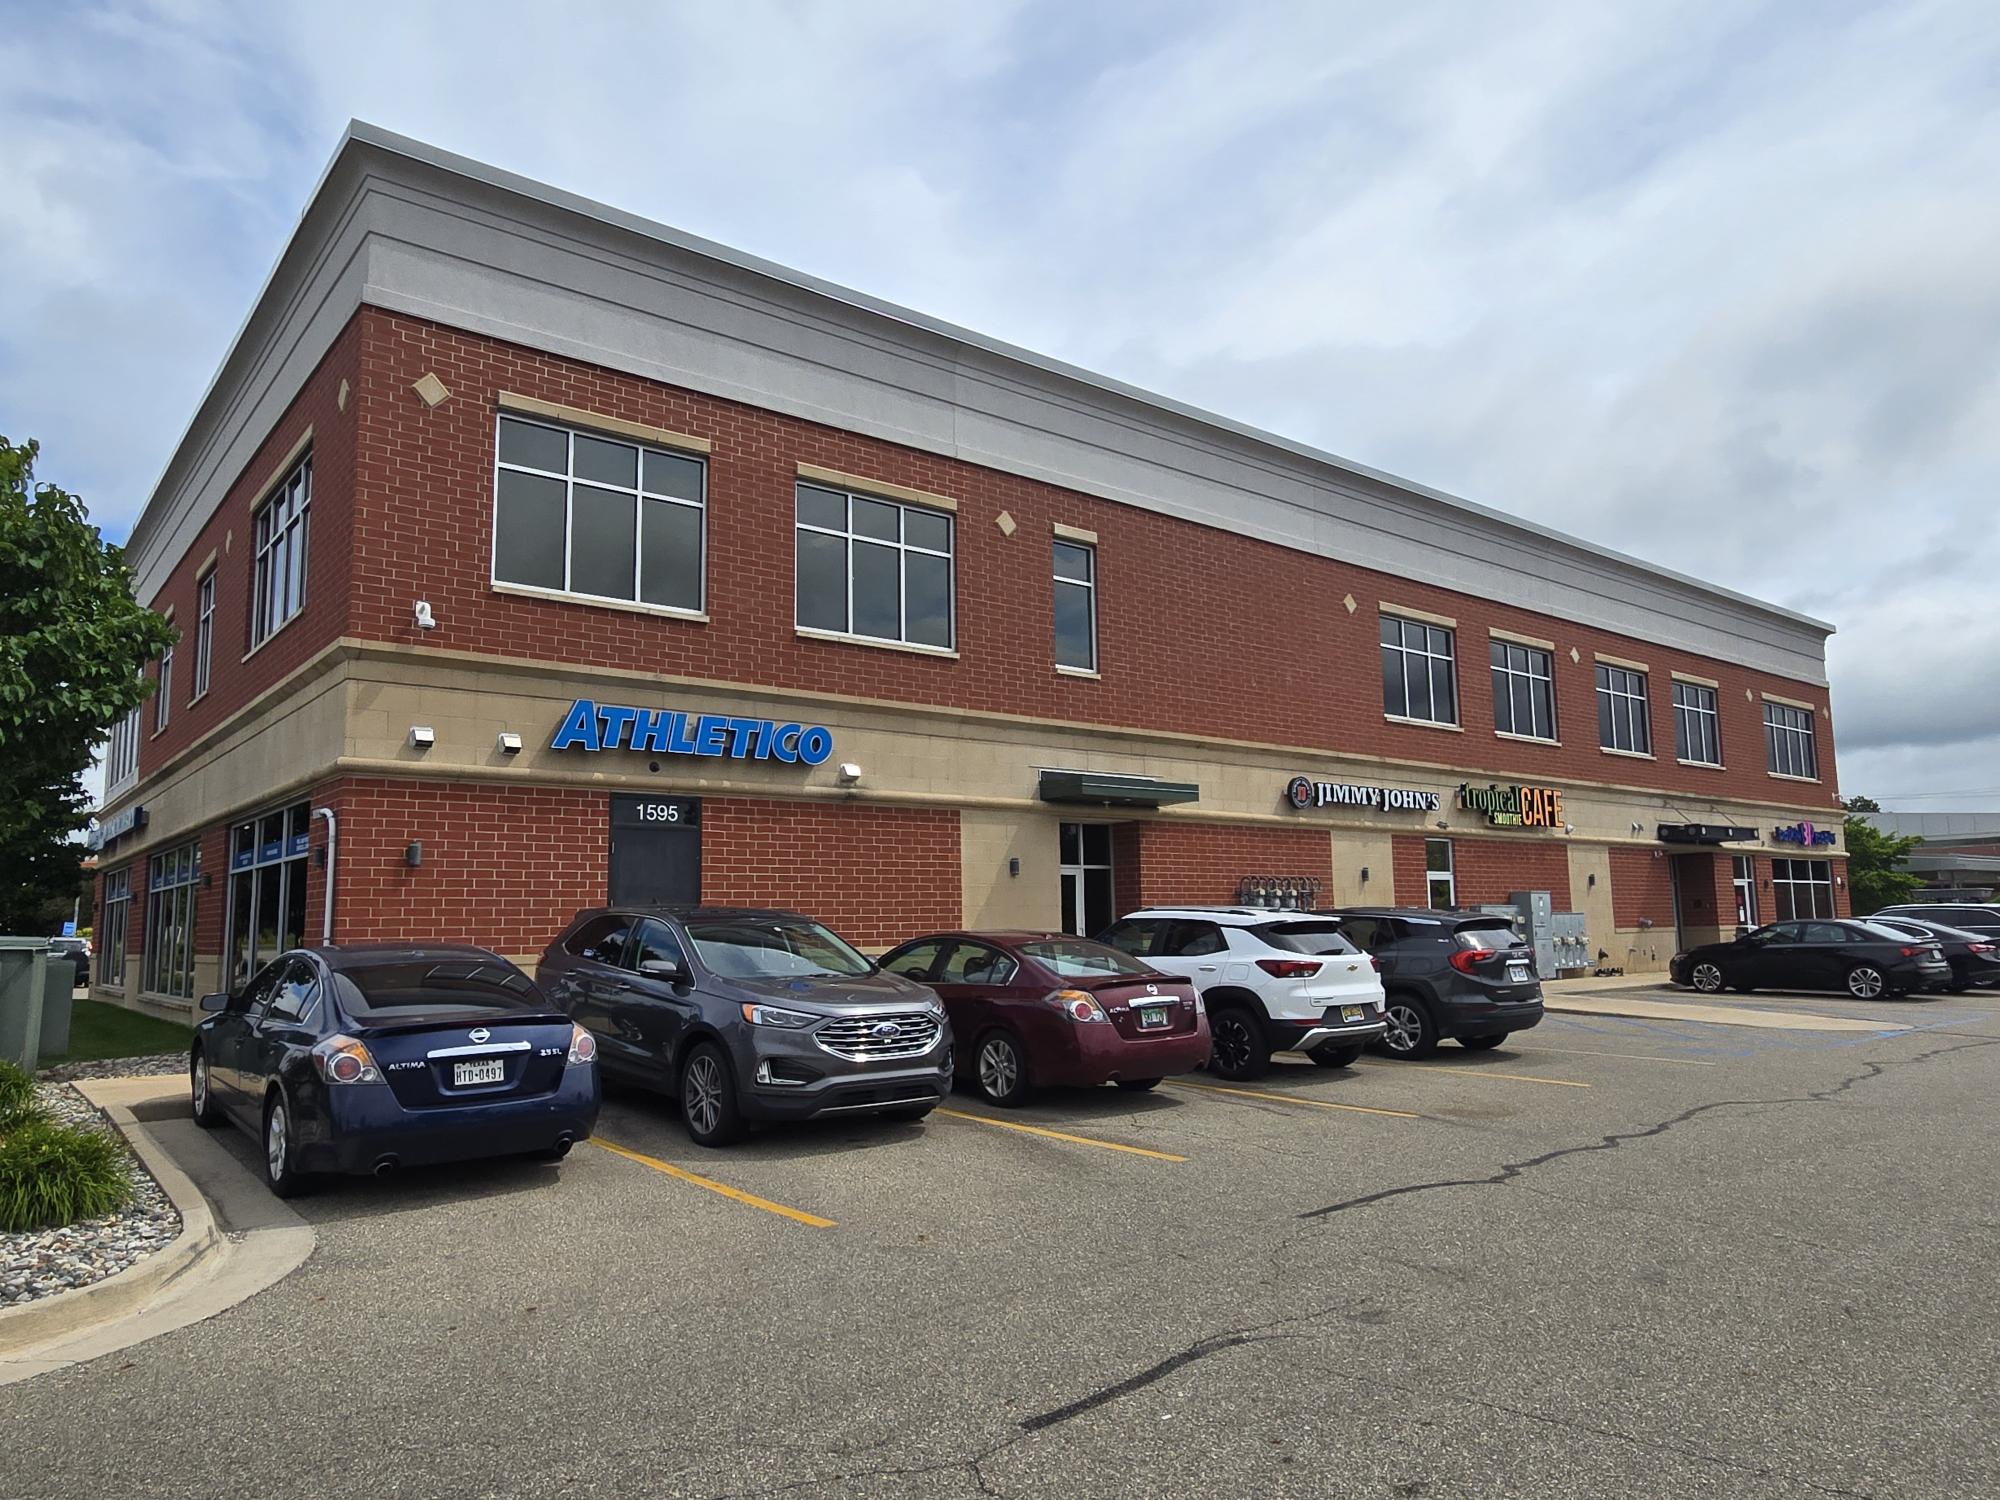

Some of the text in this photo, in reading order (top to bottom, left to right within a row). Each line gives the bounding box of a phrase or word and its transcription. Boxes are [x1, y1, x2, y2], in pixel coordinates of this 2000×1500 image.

[551, 698, 833, 766] ATHLETICO
[1317, 783, 1379, 807] JIMMY
[1383, 788, 1440, 812] JOHN'S
[1465, 783, 1564, 827] tropical CAFE
[636, 804, 679, 823] 1595
[1493, 812, 1522, 826] SMOOTHIE
[388, 1061, 427, 1071] ALTIMA
[470, 1060, 490, 1068] TEXAS
